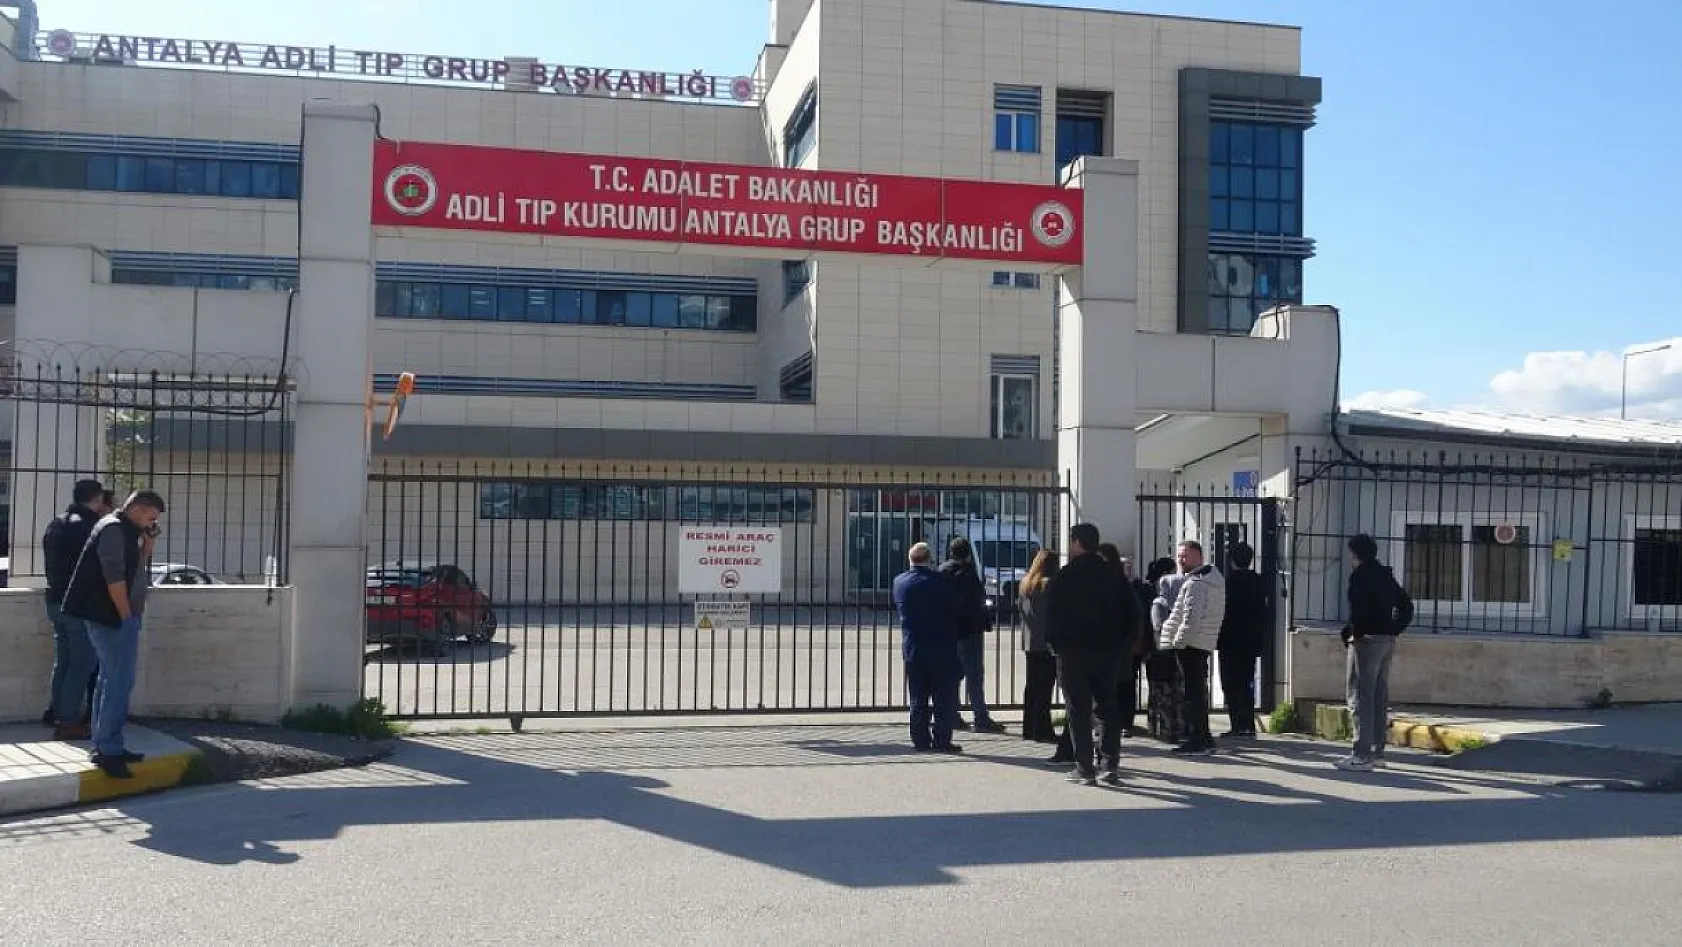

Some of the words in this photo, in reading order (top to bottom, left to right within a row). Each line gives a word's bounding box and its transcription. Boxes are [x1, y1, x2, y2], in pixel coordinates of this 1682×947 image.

[93, 34, 244, 66] ANTALYA
[260, 44, 335, 72] ADLİ
[355, 51, 404, 76] TIP
[423, 56, 511, 82] GRUP
[529, 63, 716, 97] BAŞKANLIĞI
[590, 165, 635, 193] T.C.
[642, 169, 740, 199] ADALET
[749, 176, 879, 208] BAKANLIĞI
[445, 191, 505, 224] ADLİ
[516, 198, 557, 226] TIP
[564, 202, 676, 232] KURUMU
[685, 209, 792, 238] ANTALYA
[799, 215, 866, 243] GRUP
[877, 220, 1024, 254] BAŞKANLIĞI
[686, 531, 729, 541] RESMİ
[736, 533, 775, 543] ARAÇ
